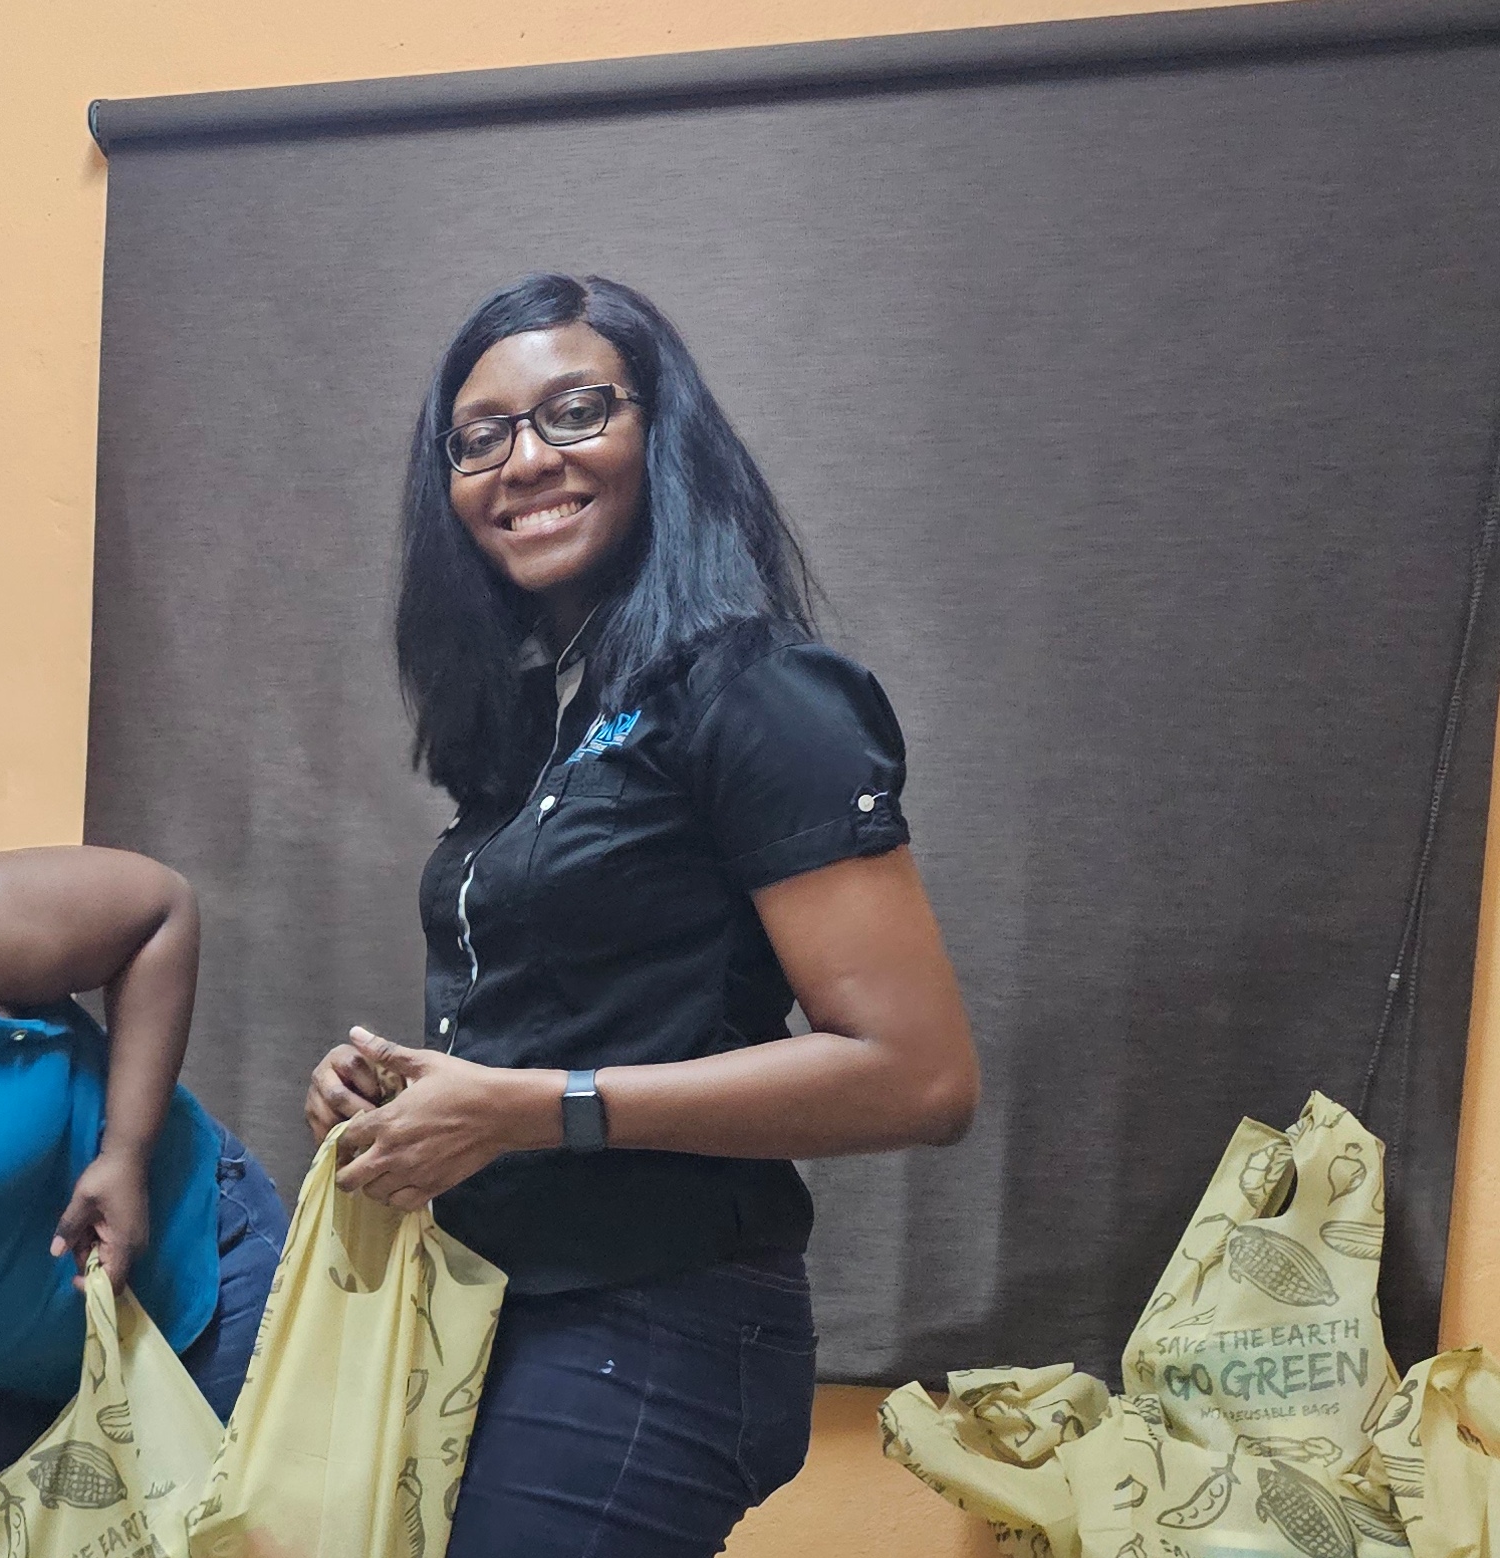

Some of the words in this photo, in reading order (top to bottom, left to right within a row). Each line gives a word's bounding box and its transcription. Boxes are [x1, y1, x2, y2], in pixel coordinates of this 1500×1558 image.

[1156, 1336, 1207, 1357] SAVE
[1212, 1328, 1264, 1353] THE
[1270, 1317, 1360, 1347] EARTH
[1164, 1363, 1213, 1401] GO
[1220, 1348, 1369, 1401] GREEN
[1302, 1402, 1340, 1416] BAGS
